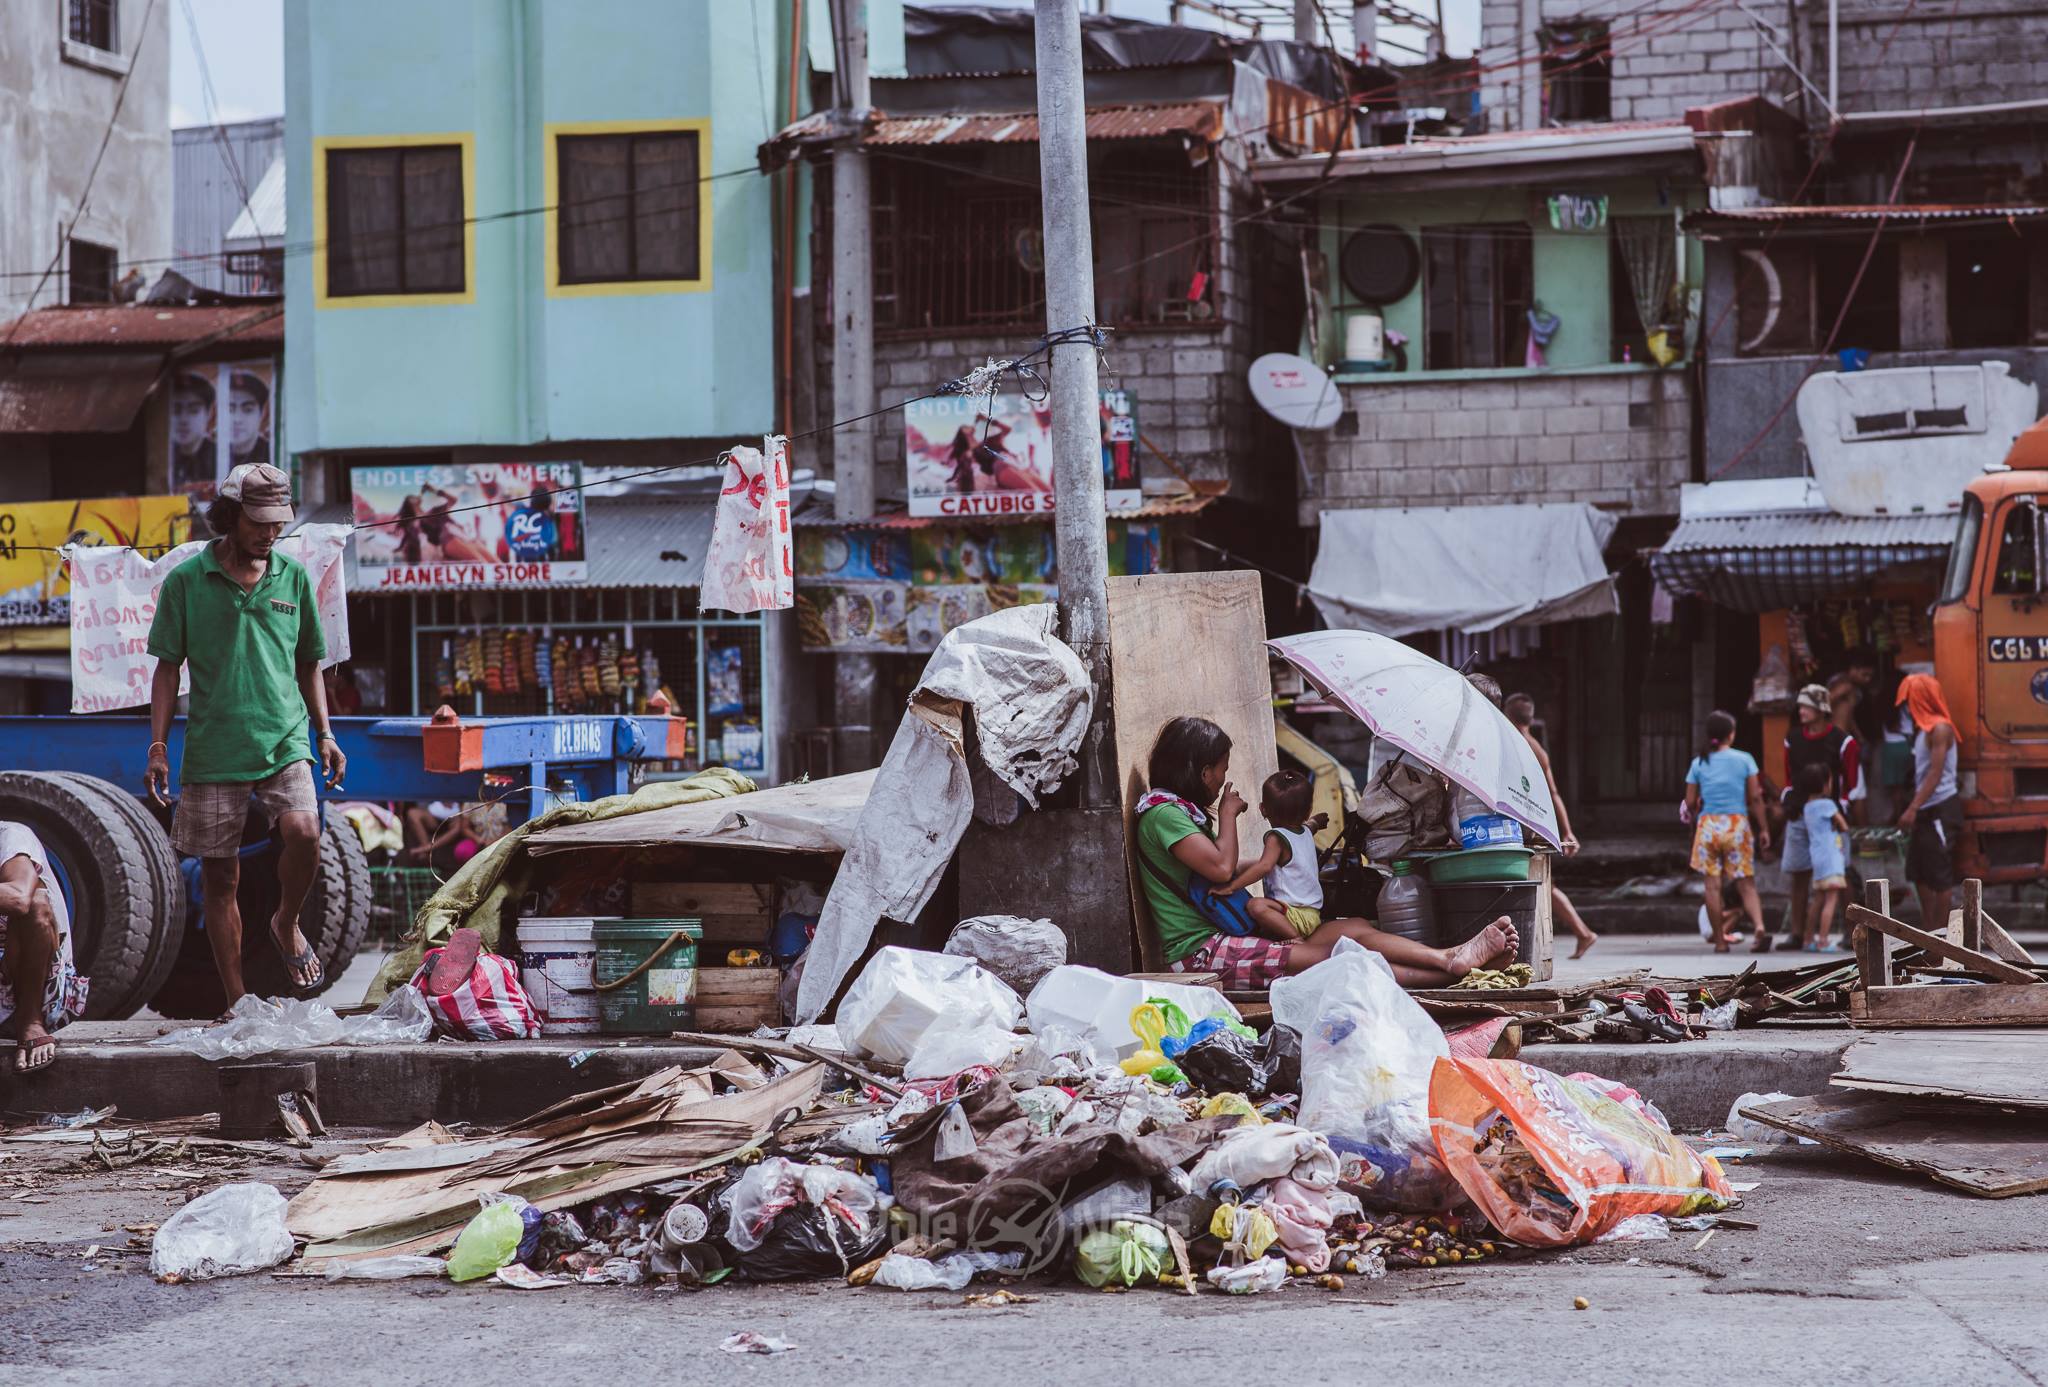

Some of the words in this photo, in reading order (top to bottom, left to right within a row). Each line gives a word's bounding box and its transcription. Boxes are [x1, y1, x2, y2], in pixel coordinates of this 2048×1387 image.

[352, 470, 454, 488] ENDLESS
[940, 494, 1035, 514] CATUBIG
[512, 512, 543, 540] RC
[380, 566, 486, 588] JEANELYN
[494, 563, 552, 583] STORE
